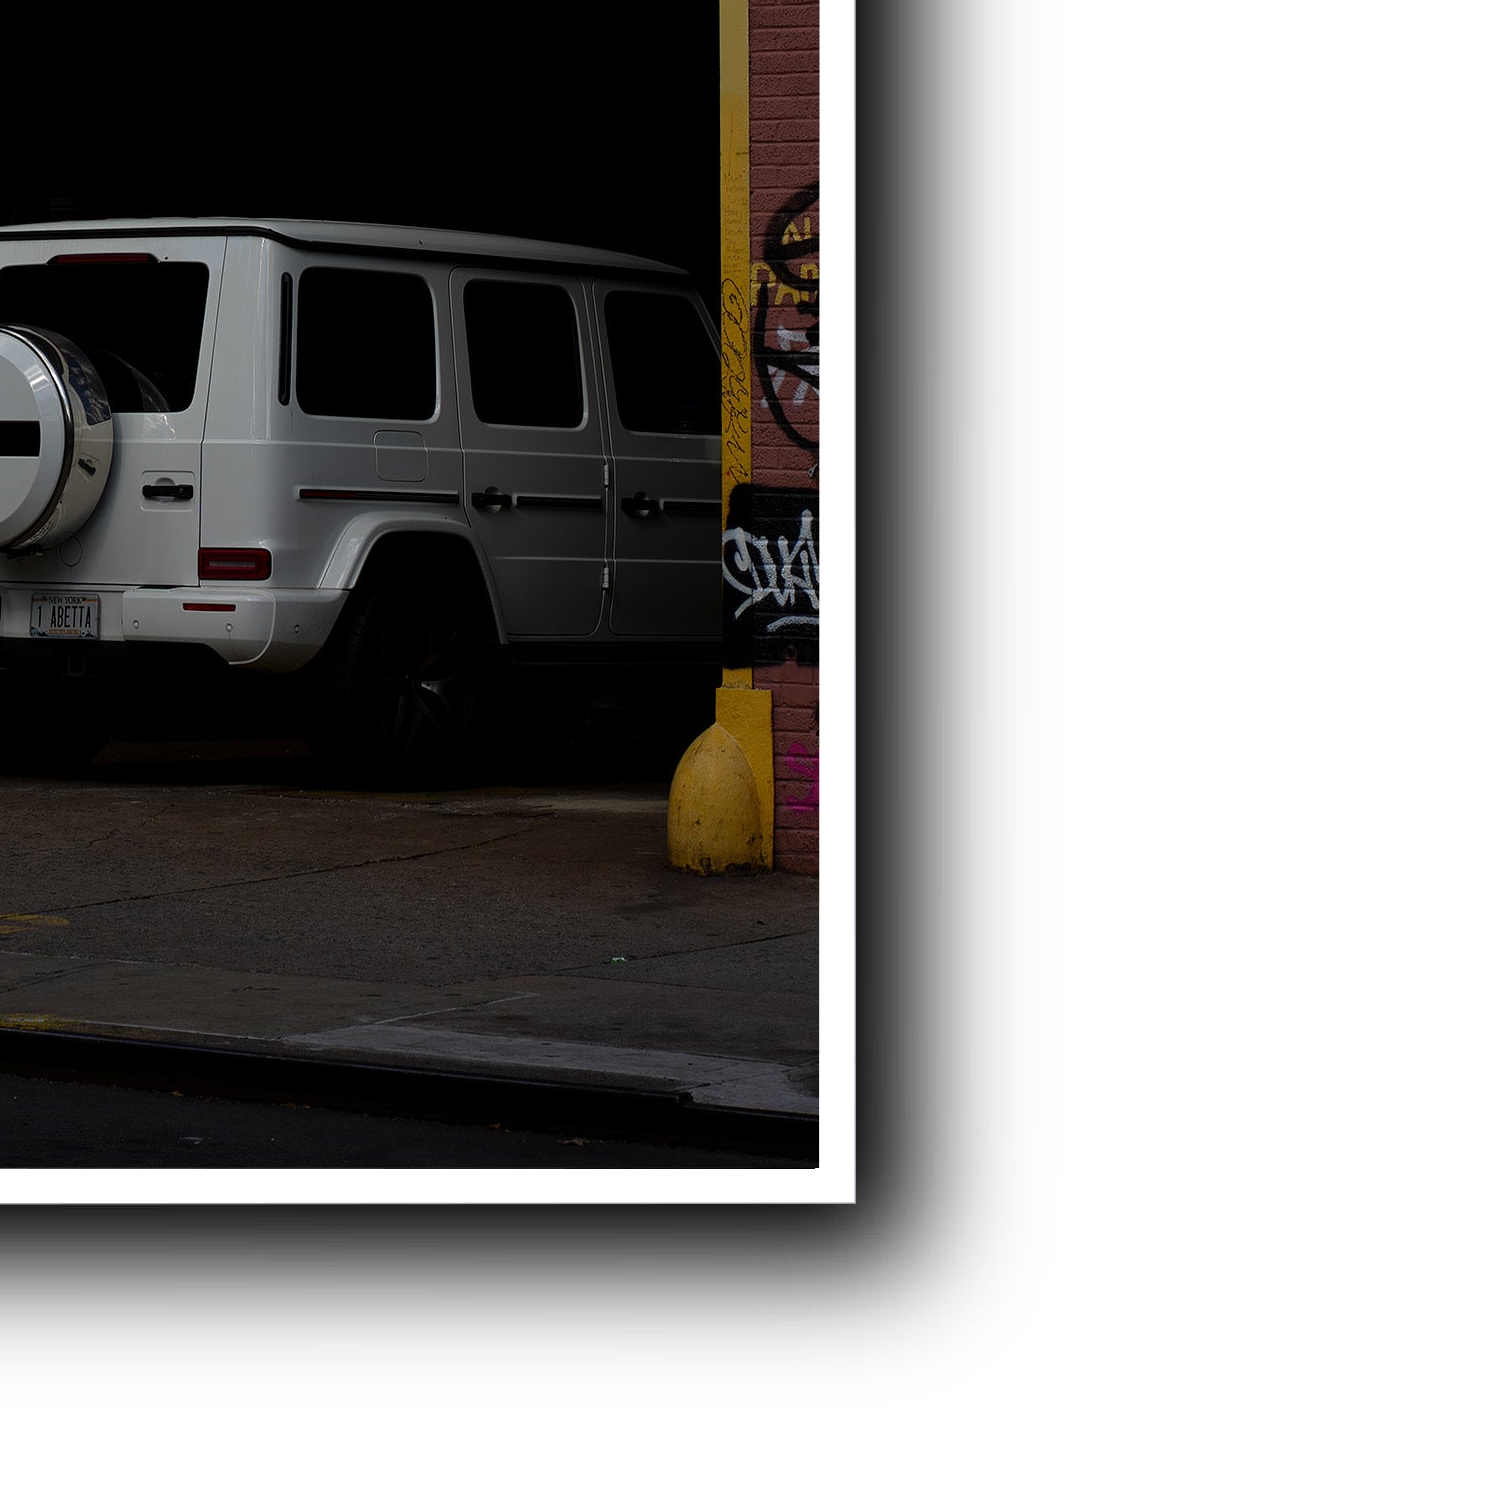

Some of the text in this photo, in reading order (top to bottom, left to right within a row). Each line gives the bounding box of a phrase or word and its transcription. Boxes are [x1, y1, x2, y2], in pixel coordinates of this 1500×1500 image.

[48, 596, 83, 605] NEW YORK
[37, 605, 91, 629] 1 ABETTA
